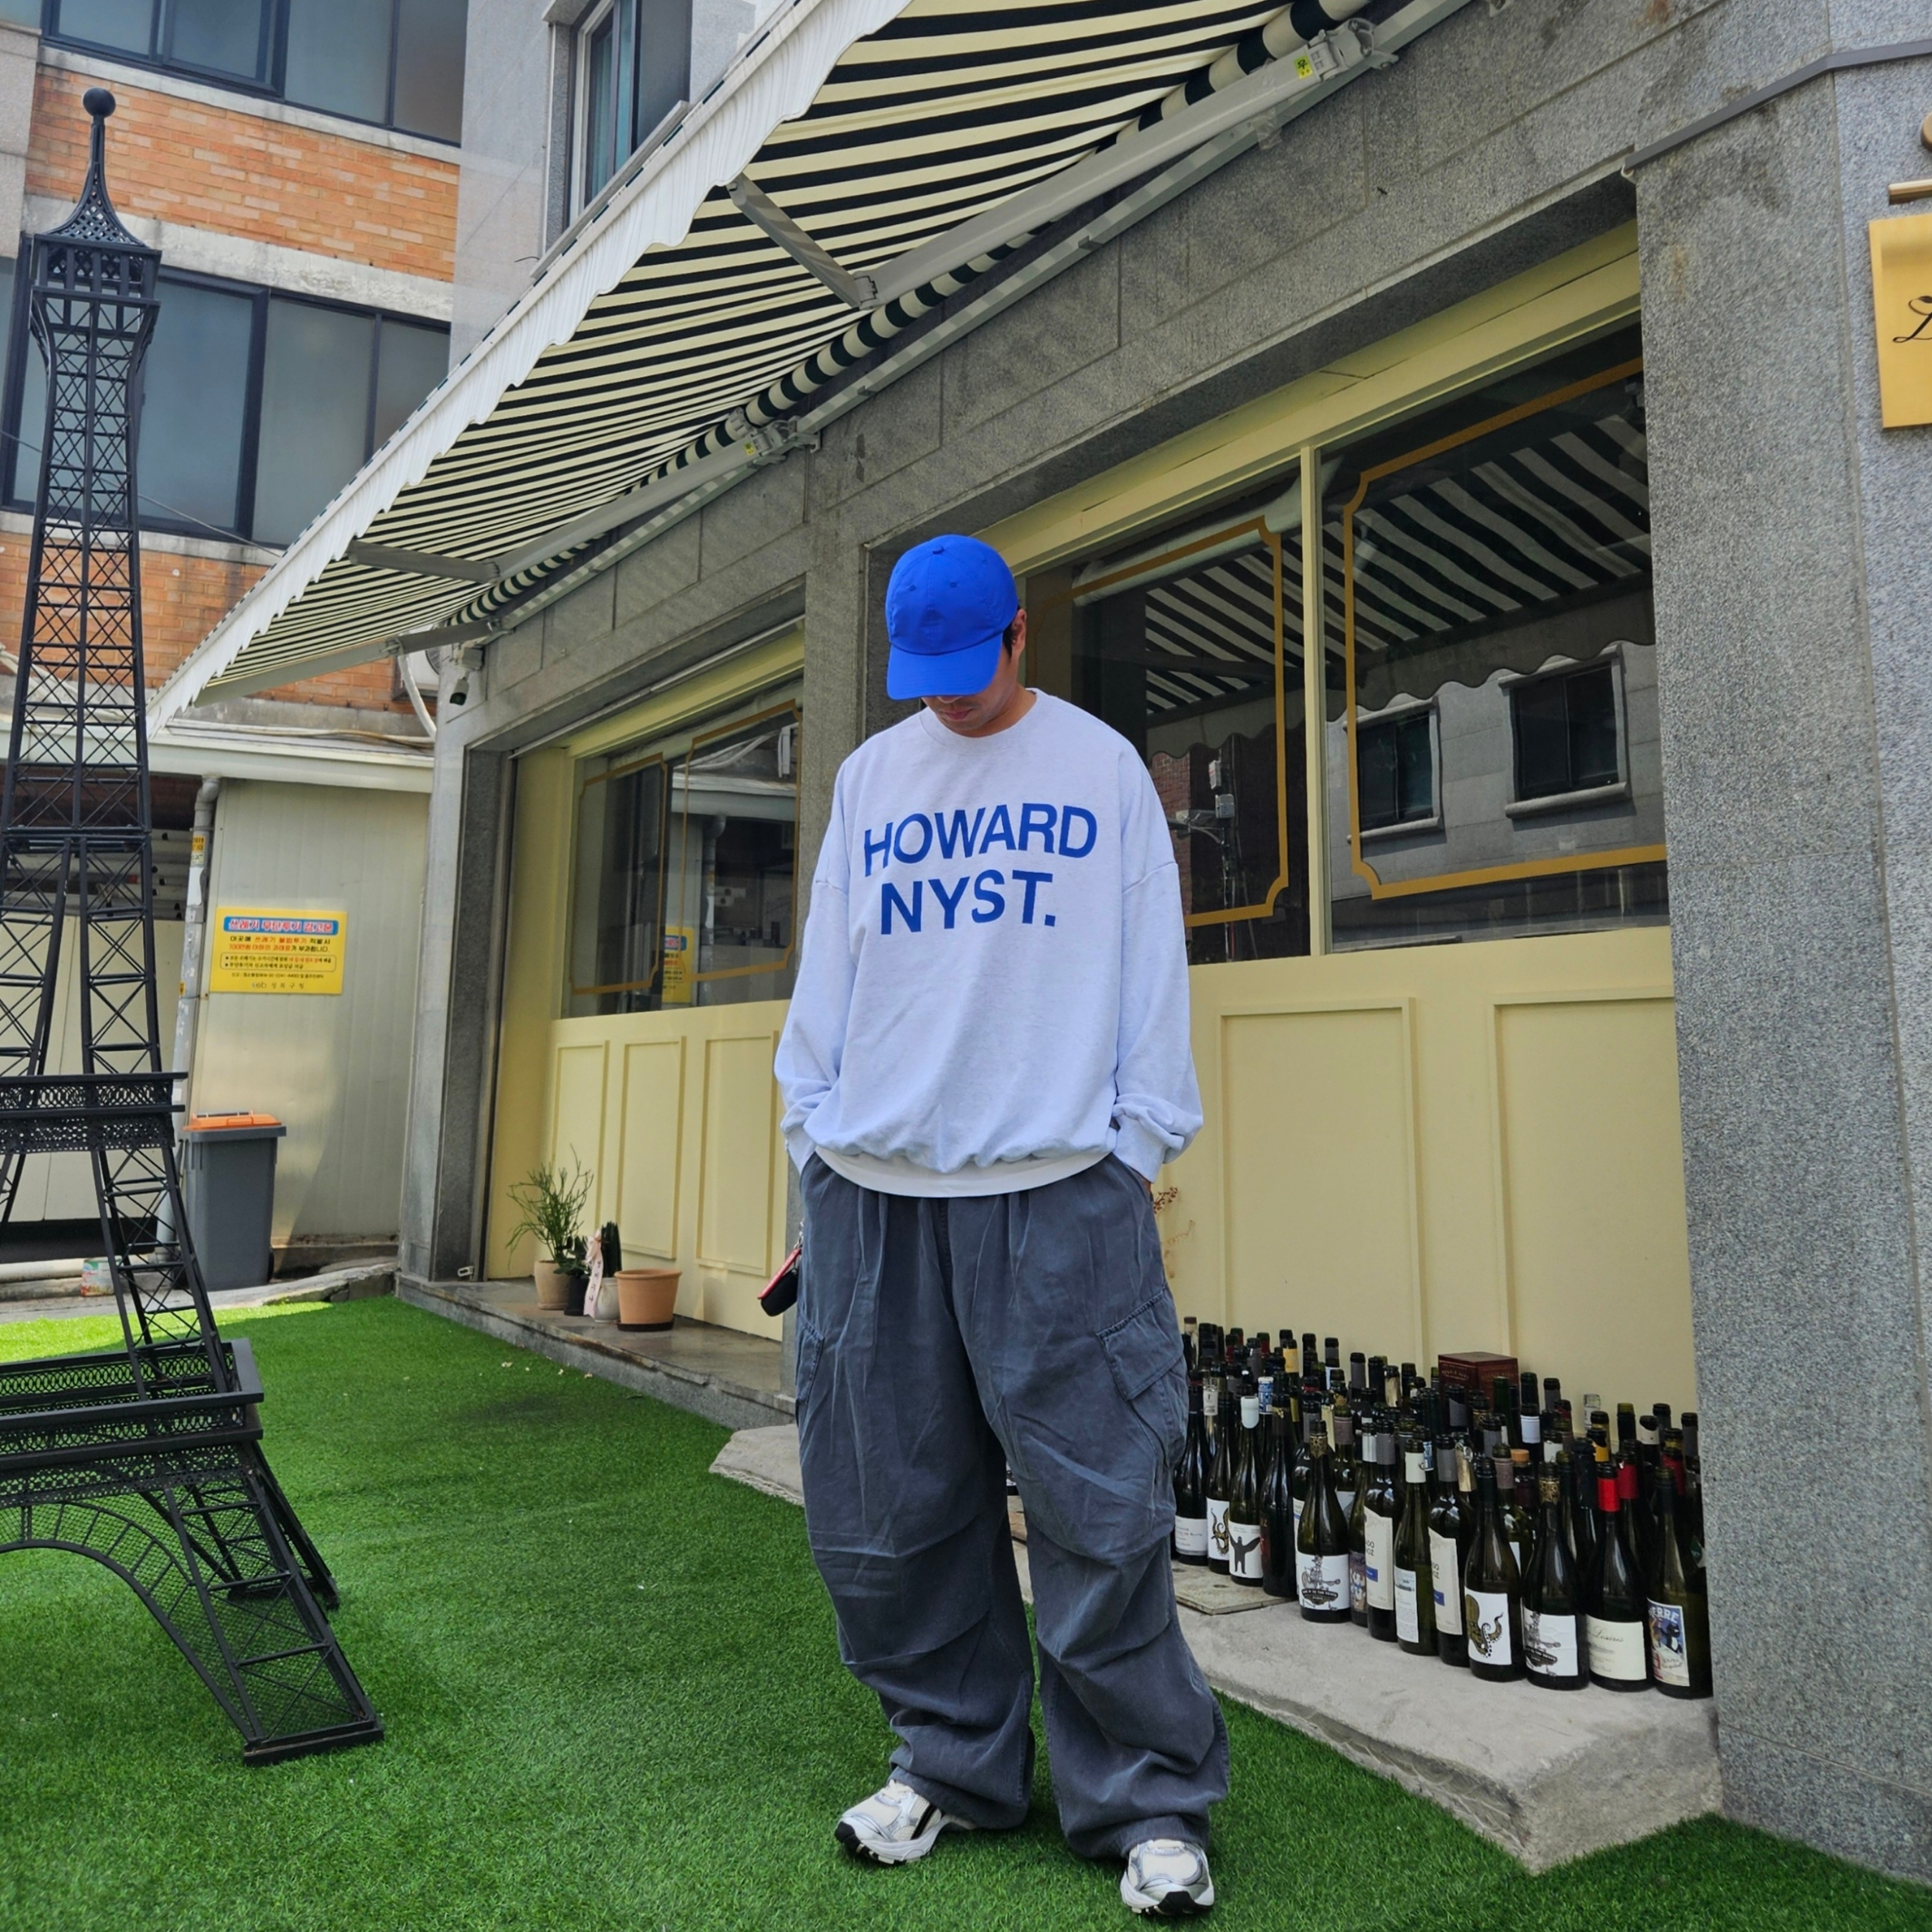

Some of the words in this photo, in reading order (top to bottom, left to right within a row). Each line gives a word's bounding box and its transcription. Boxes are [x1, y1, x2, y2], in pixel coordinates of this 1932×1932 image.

[864, 802, 1097, 878] HOWARD
[880, 869, 1056, 936] NYST.
[228, 918, 260, 931] 쓰레기
[262, 919, 302, 933] 무단투기
[229, 935, 251, 943] 이곳에
[254, 936, 277, 944] 쓰레기
